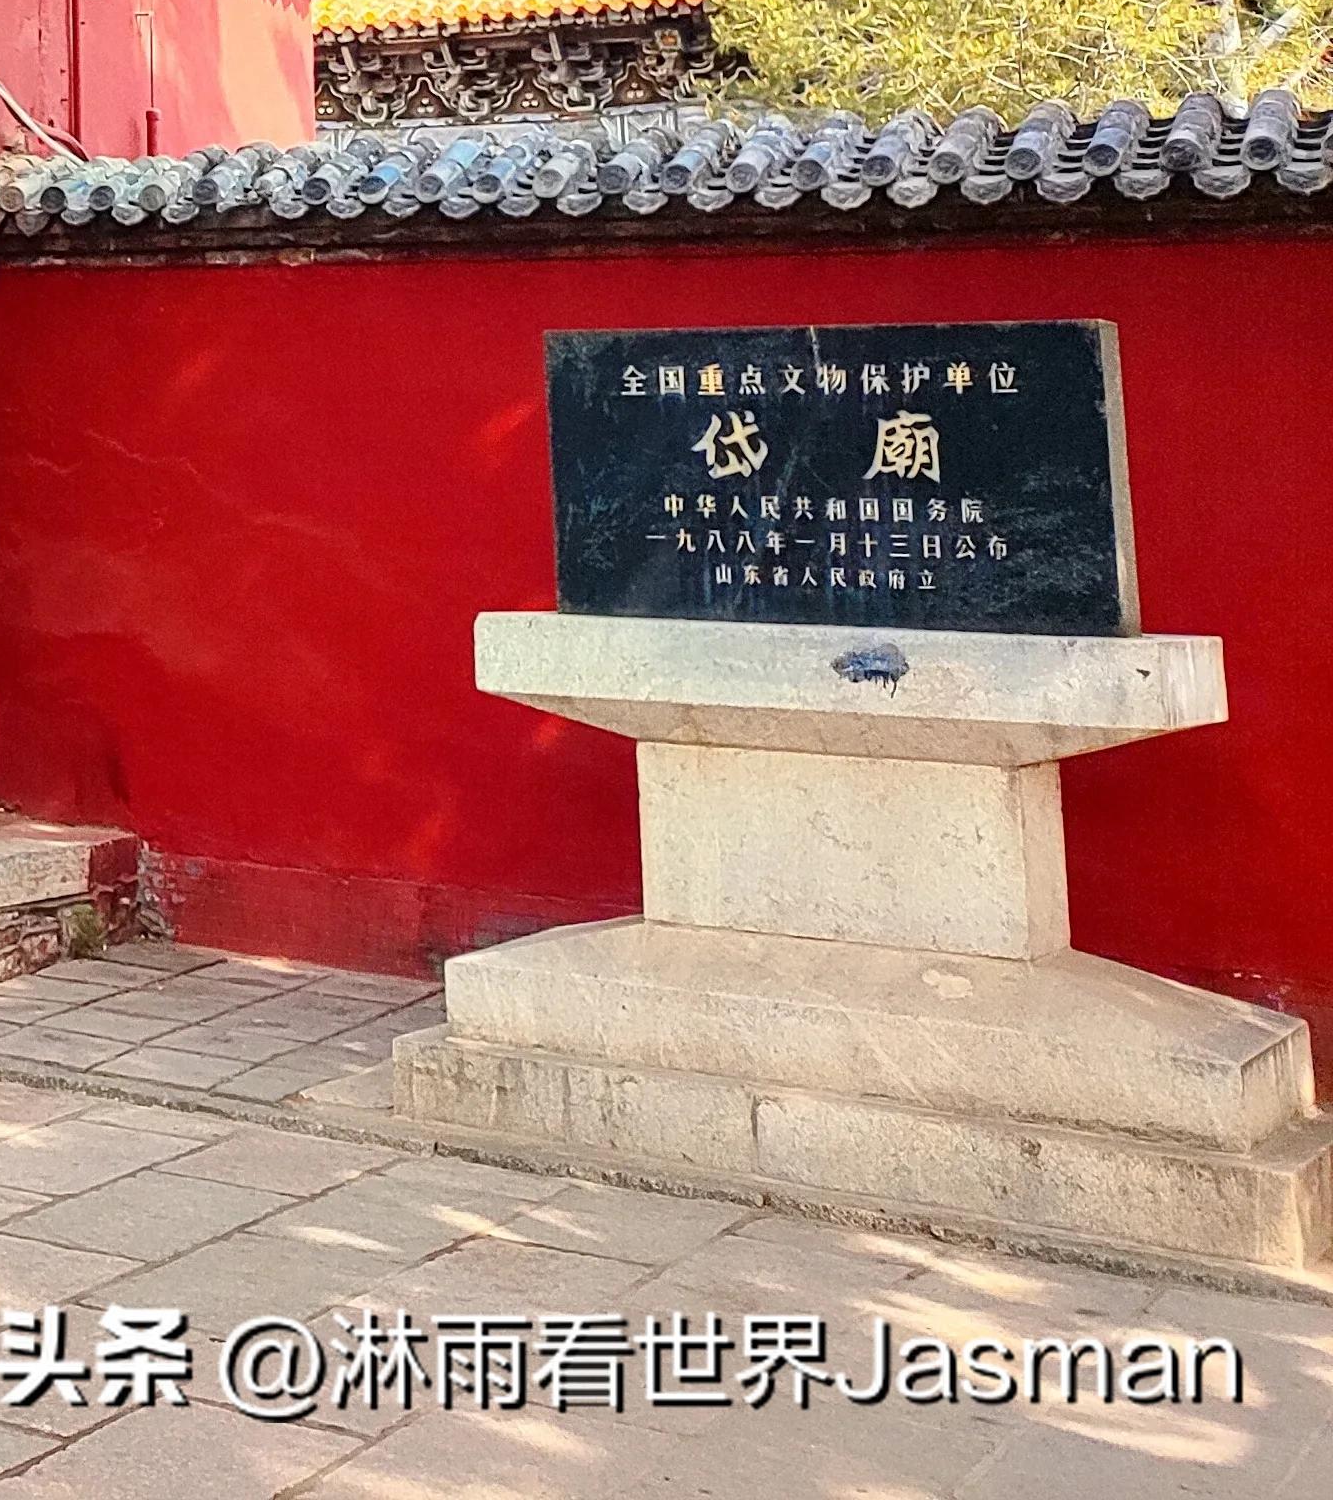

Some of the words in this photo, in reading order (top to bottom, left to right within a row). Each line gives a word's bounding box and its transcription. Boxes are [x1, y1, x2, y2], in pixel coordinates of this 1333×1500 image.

[620, 362, 1019, 397] 全国重点文物保护单位
[664, 493, 985, 524] 中华人民共和国国务院
[645, 527, 1009, 561] 一九八八年一月十三日公布
[715, 562, 937, 591] 山东省人民政府立
